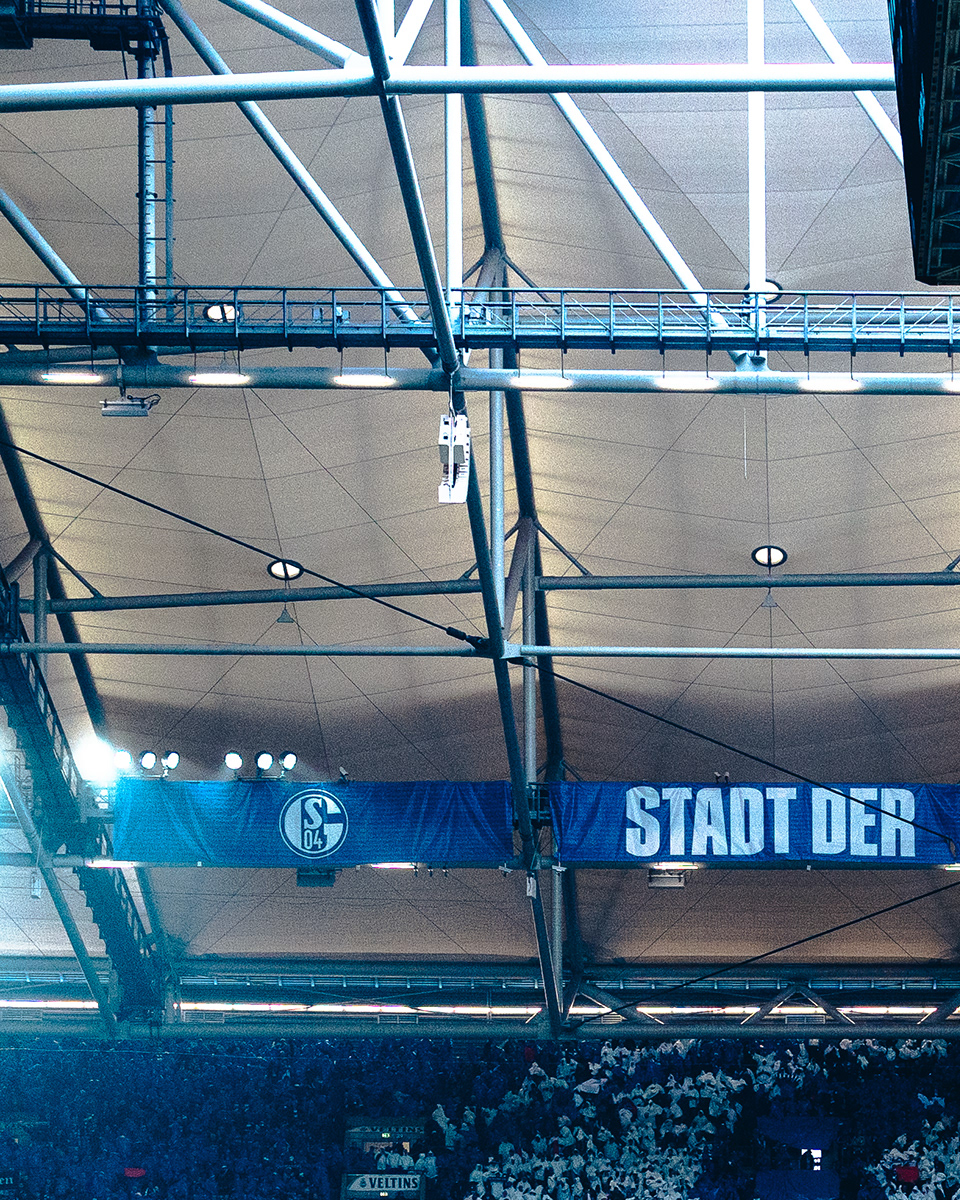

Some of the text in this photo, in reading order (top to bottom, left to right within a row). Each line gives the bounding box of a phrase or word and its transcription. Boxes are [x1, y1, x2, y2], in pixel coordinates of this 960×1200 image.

[625, 785, 916, 857] STADT DER
[368, 1177, 419, 1189] VELTINS
